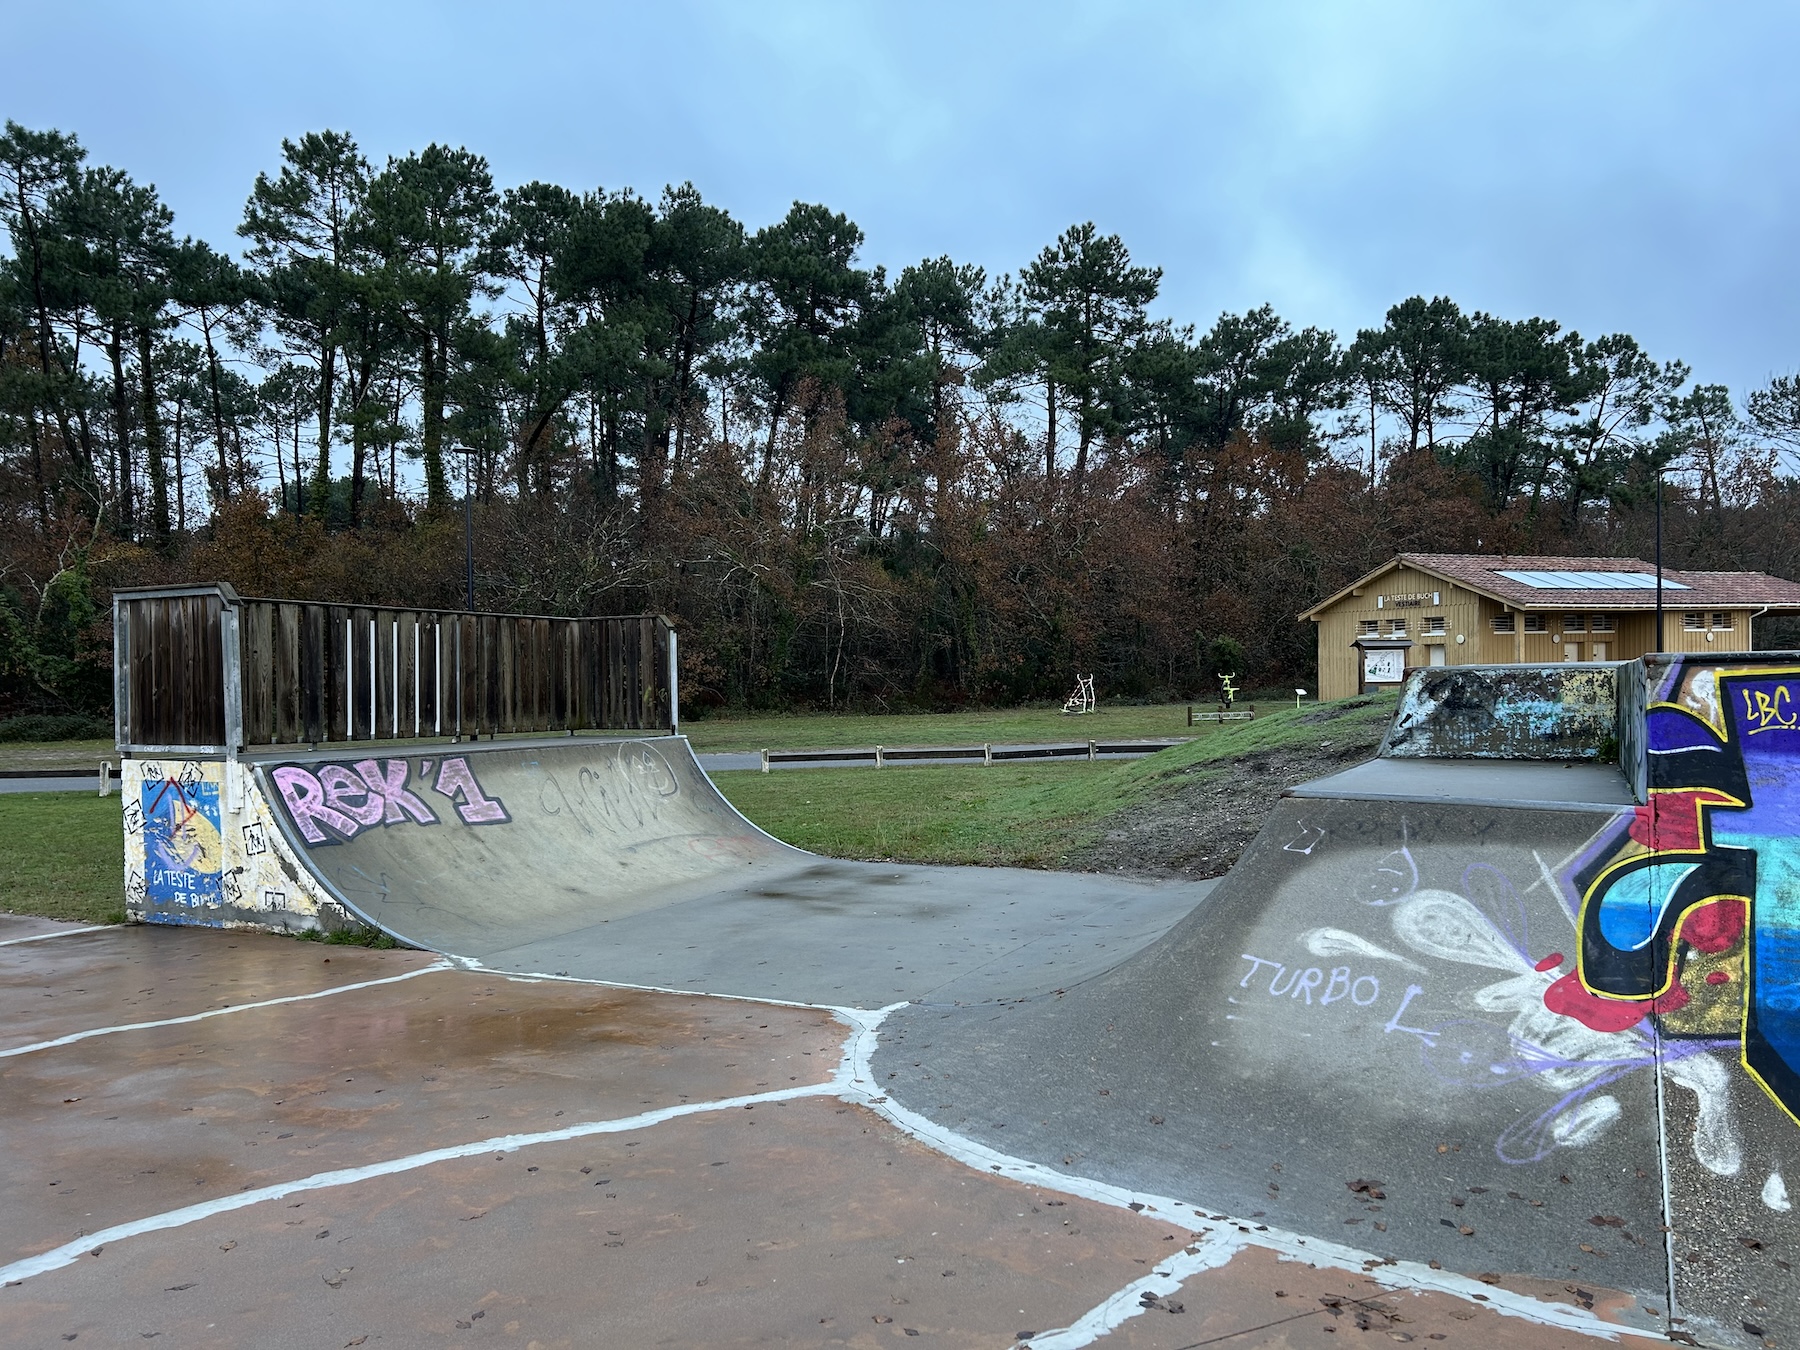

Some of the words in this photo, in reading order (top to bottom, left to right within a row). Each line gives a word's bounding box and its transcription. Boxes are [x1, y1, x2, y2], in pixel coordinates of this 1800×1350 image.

[1742, 685, 1797, 727] LBC
[153, 869, 164, 886] LA
[164, 870, 196, 890] TESTE
[174, 891, 187, 904] DE
[1240, 953, 1381, 1007] TURBO
